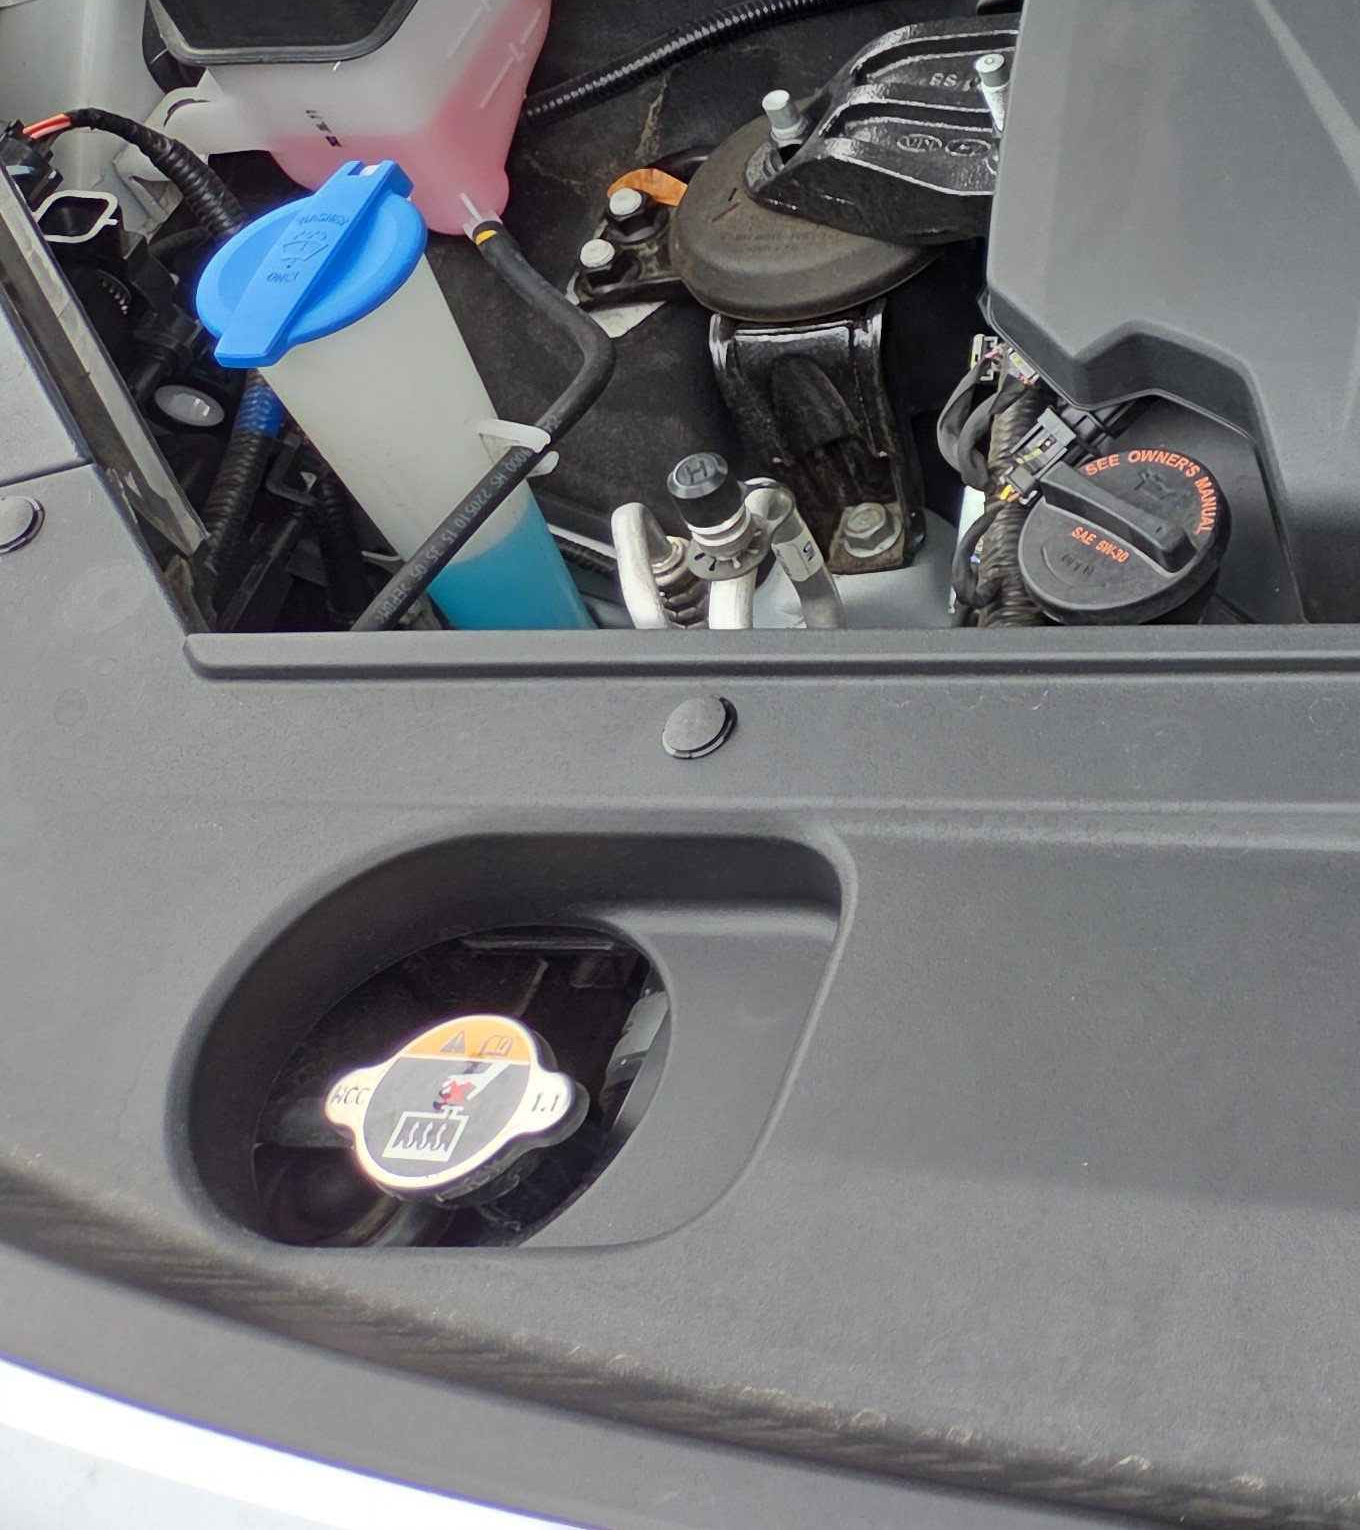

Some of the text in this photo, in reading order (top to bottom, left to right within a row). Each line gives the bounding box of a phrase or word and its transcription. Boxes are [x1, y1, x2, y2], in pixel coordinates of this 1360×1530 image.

[1084, 449, 1218, 536] SEE OWNER'S MANUAL
[1070, 526, 1130, 563] SAE 5W-30
[330, 1085, 370, 1106] HCC
[531, 1091, 563, 1114] 1.1
